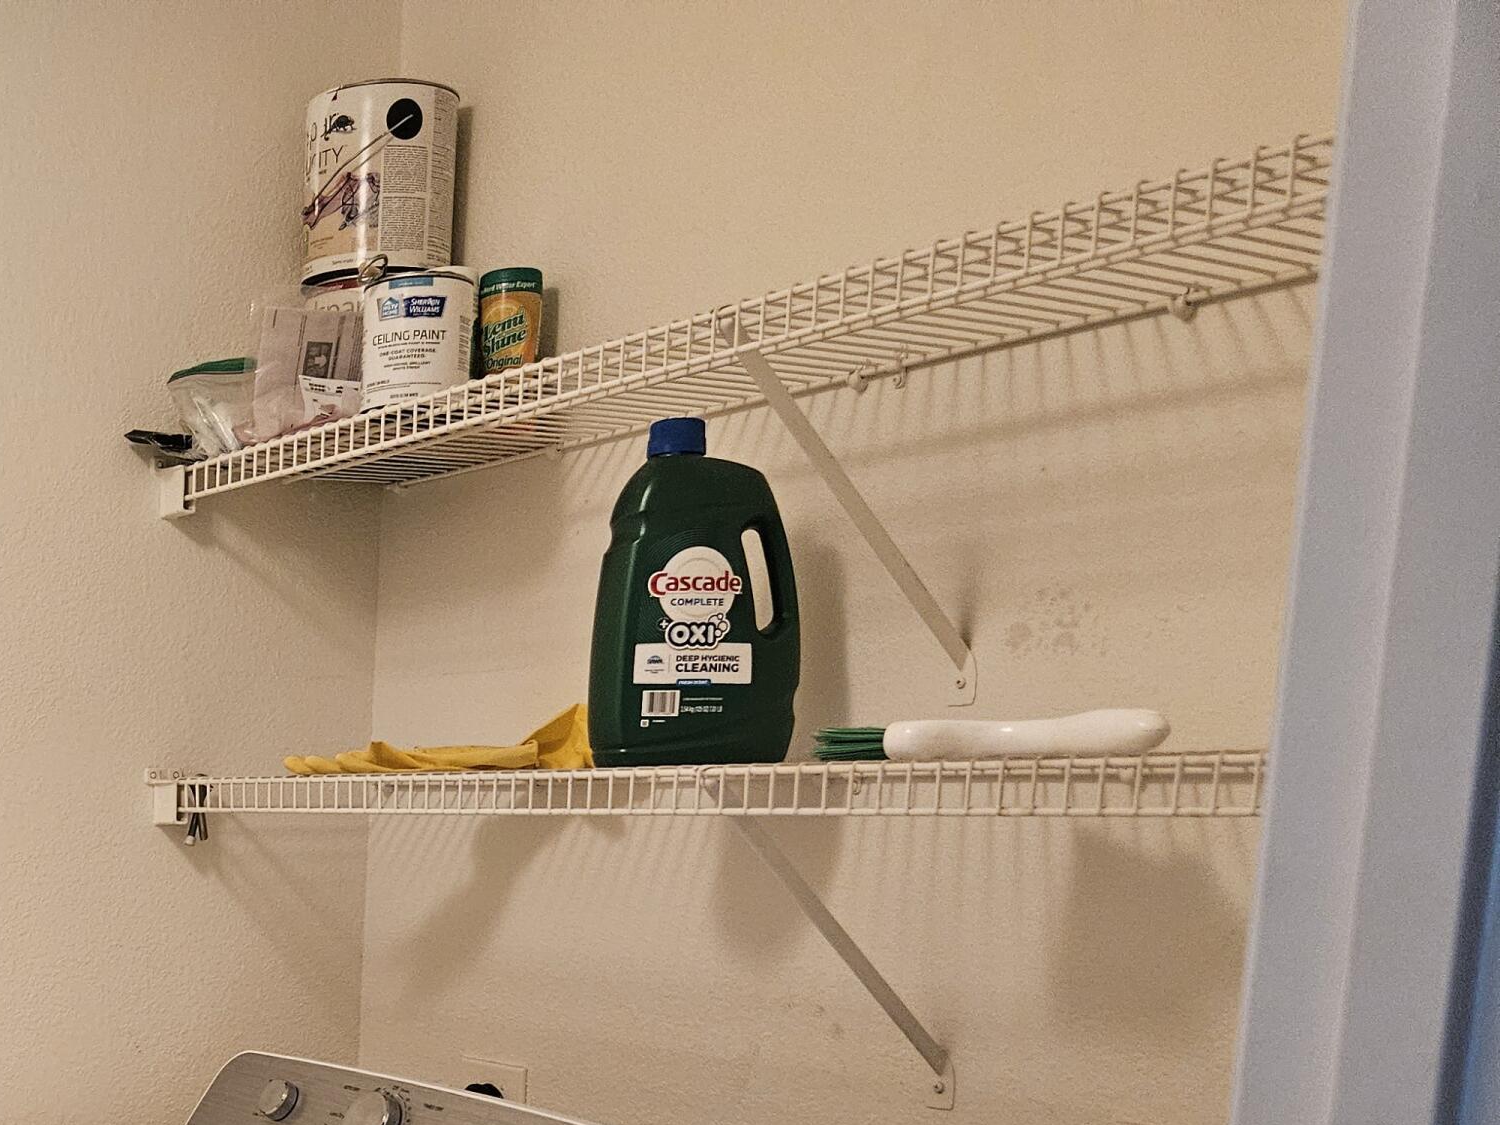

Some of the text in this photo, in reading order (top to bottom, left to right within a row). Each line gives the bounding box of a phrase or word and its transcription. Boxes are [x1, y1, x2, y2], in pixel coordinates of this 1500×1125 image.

[372, 330, 410, 346] CEILING
[413, 329, 447, 341] PAINT
[483, 329, 526, 356] Shine
[487, 354, 523, 369] Original
[650, 571, 741, 596] Cascade
[670, 598, 725, 607] COMPLETE
[668, 622, 716, 646] OXI
[675, 663, 740, 673] CLEANING
